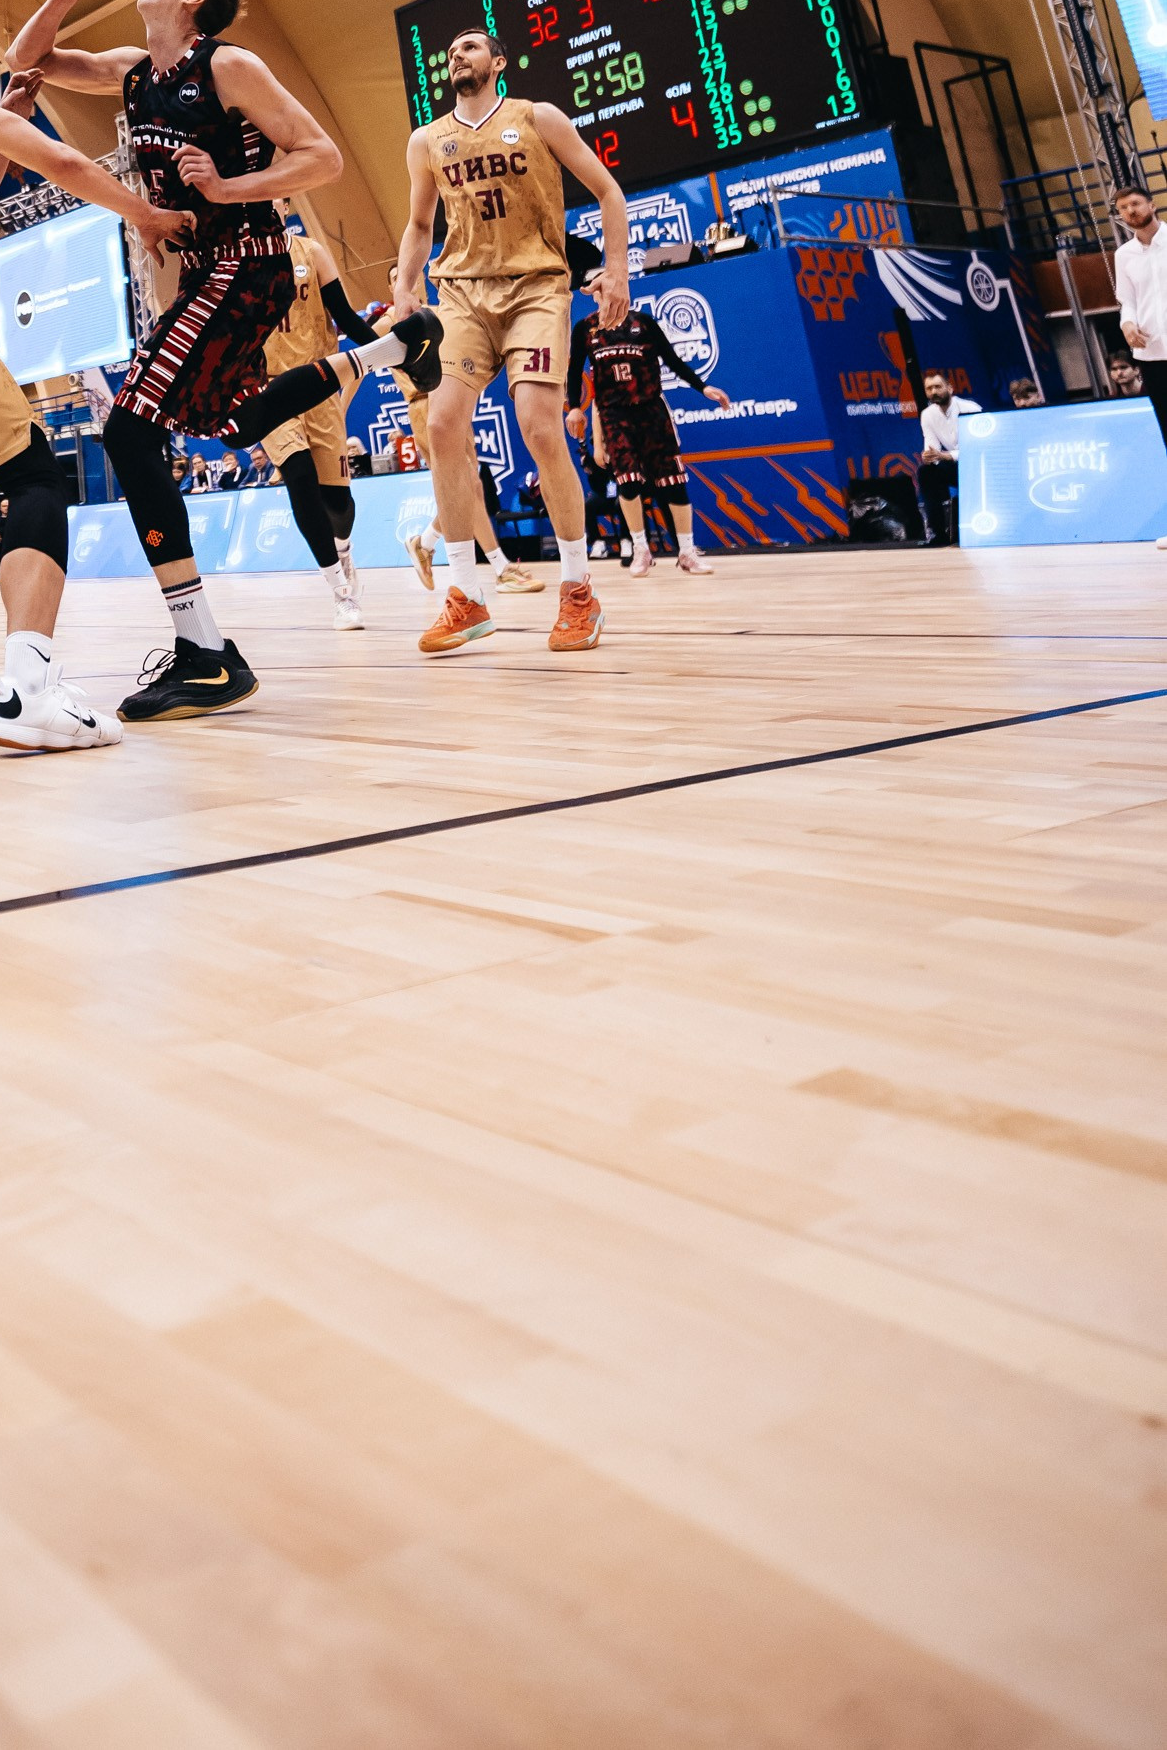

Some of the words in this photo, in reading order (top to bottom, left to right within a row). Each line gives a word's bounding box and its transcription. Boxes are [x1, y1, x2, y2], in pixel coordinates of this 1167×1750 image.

[485, 10, 496, 29] 6
[527, 5, 561, 48] 32
[692, 4, 716, 29] 15
[410, 25, 420, 43] 2
[696, 22, 718, 48] 17
[699, 42, 724, 69] 23
[820, 5, 835, 28] 0
[703, 61, 727, 89] 27
[825, 25, 840, 49] 0
[572, 51, 645, 109] 2:58
[707, 82, 733, 109] 28
[831, 47, 843, 70] 1
[180, 88, 197, 98] РФБ
[413, 91, 430, 110] 12
[711, 103, 735, 129] 31
[835, 67, 851, 92] 6
[571, 112, 595, 129] РЕМЯ
[671, 100, 698, 139] 4
[714, 123, 742, 149] 35
[826, 90, 856, 117] 13
[442, 152, 528, 188] ЦИВС
[829, 147, 887, 174] КОМАНД
[474, 188, 507, 221] 31
[522, 347, 551, 373] 31
[611, 361, 635, 382] 12
[838, 370, 902, 402] ЦЕЛЬ
[398, 442, 415, 464] 5
